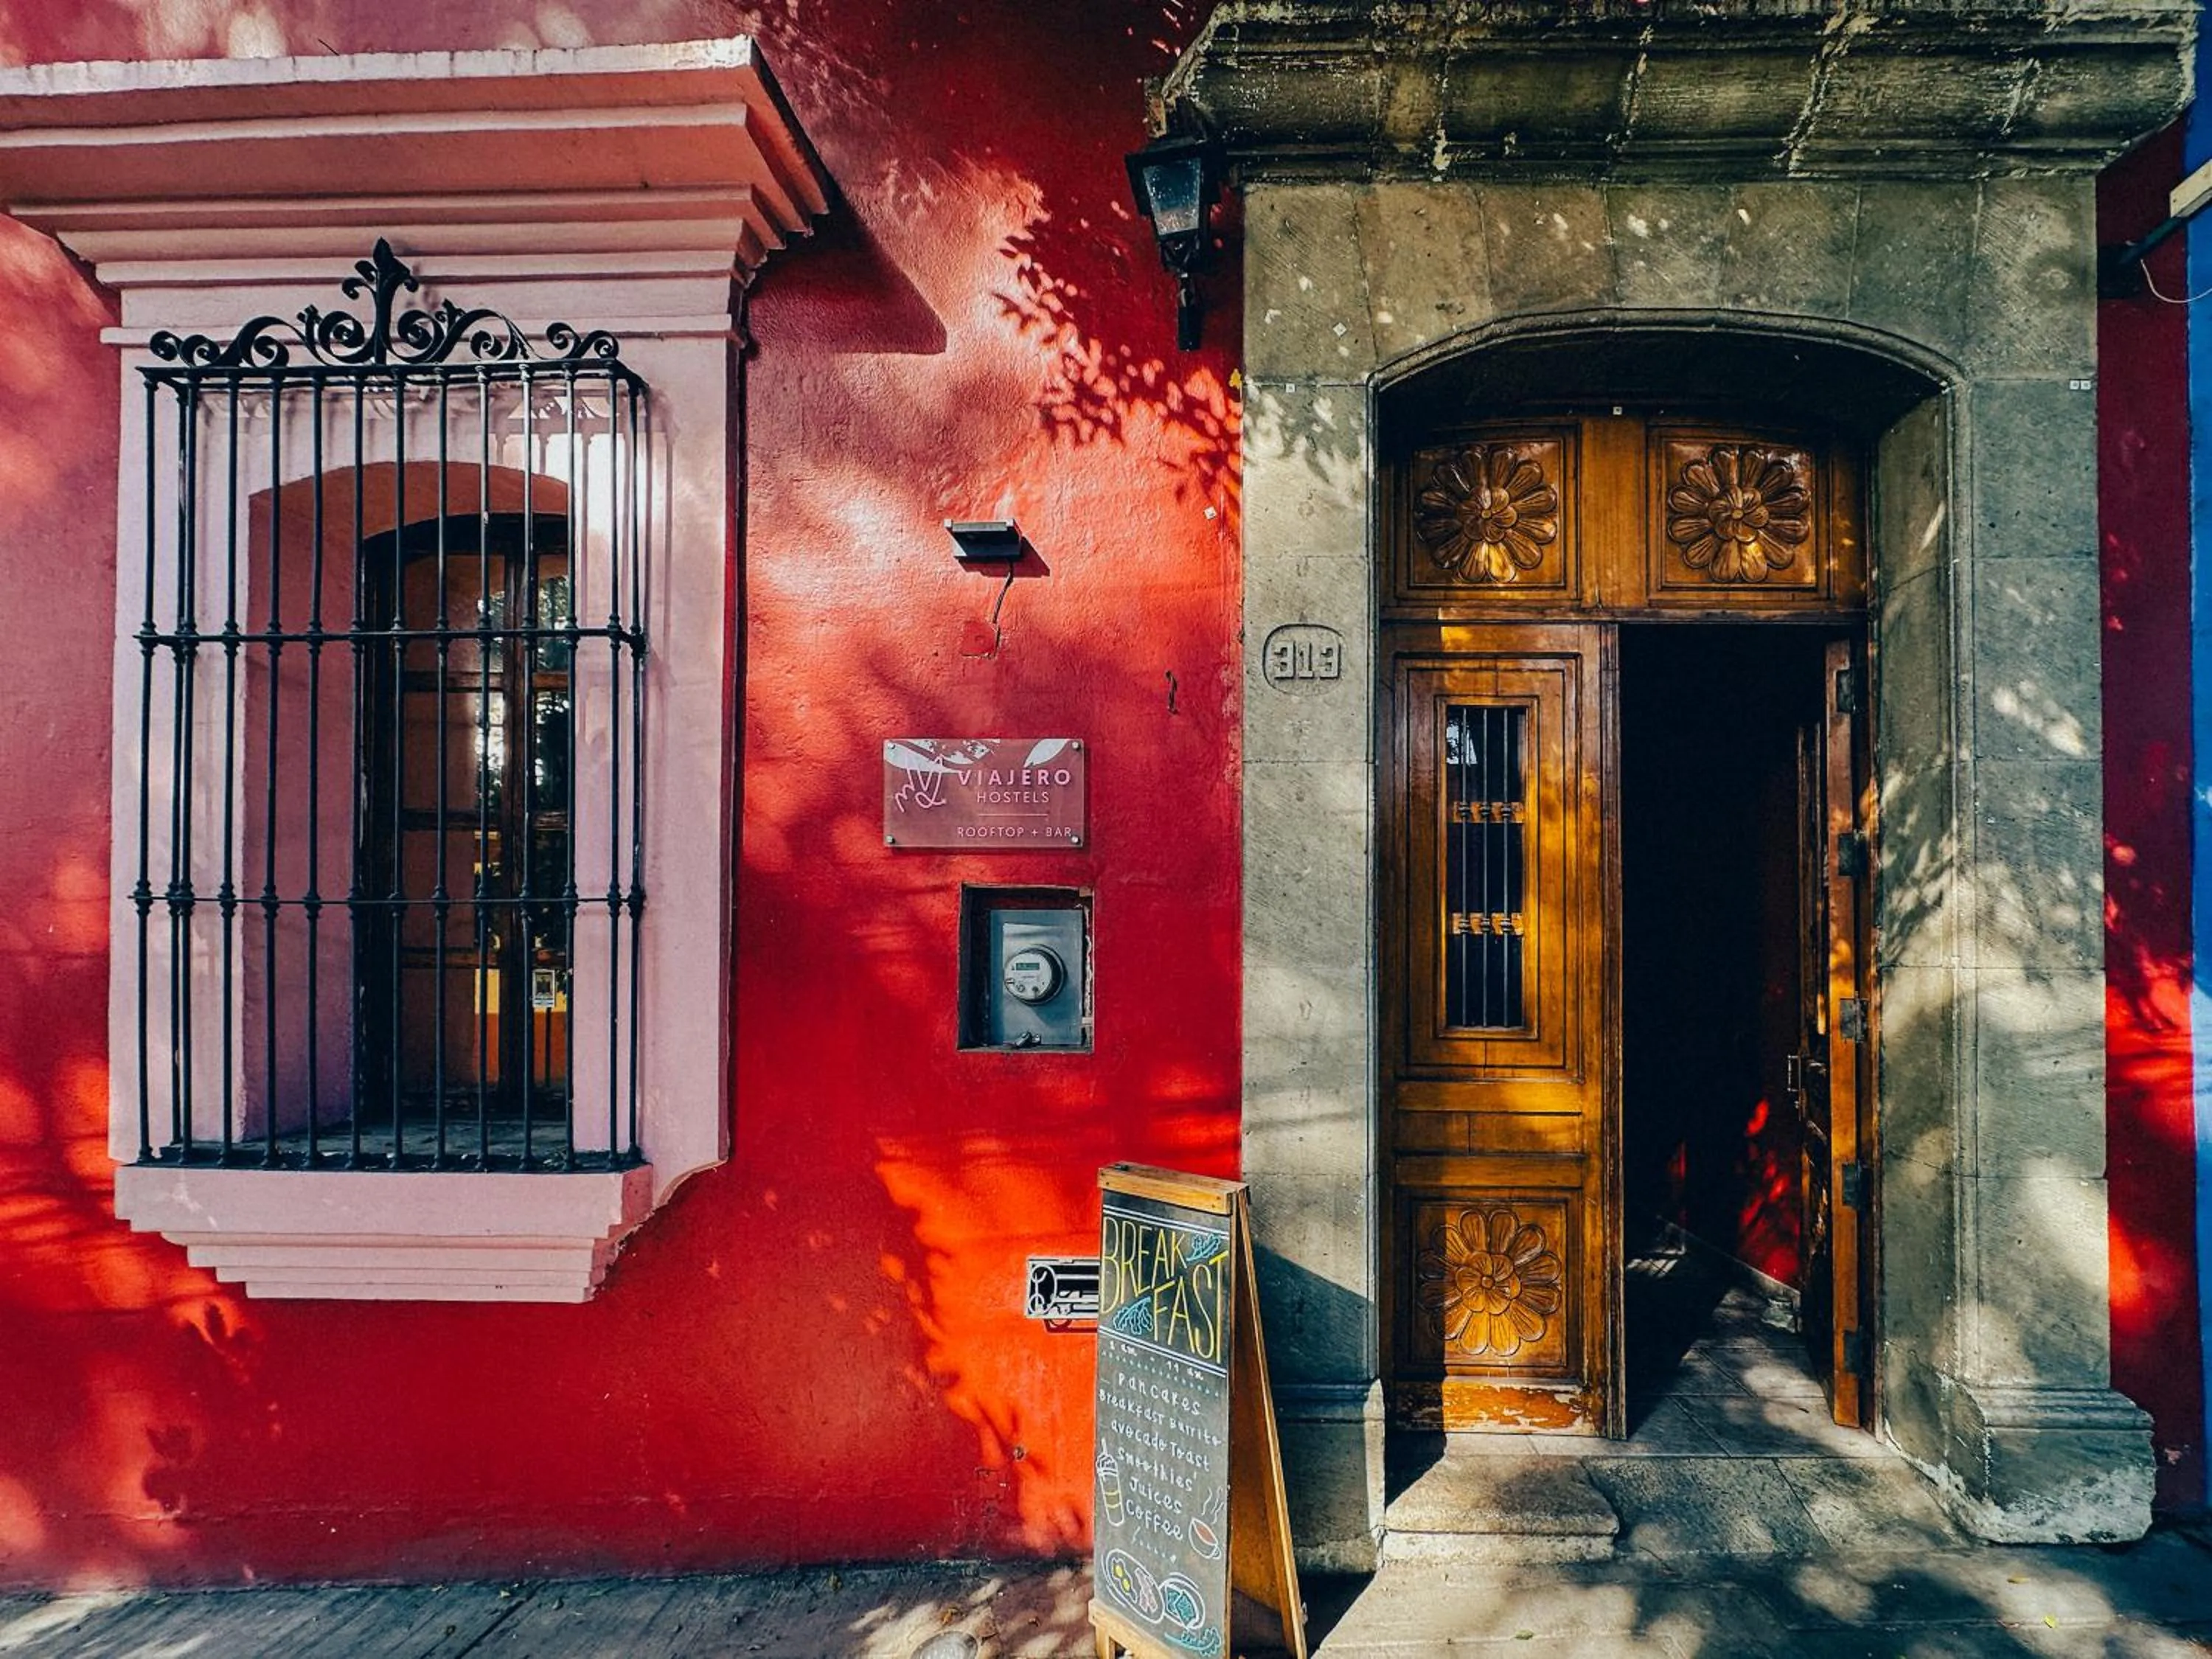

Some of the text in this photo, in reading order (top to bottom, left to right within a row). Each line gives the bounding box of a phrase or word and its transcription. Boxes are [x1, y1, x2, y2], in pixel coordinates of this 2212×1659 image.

[1273, 639, 1341, 680] 313
[959, 769, 1071, 785] VIAJERO
[977, 791, 1049, 803] HOSTELS
[958, 827, 1024, 837] ROOFTOP
[1046, 827, 1072, 837] BAR
[1101, 1216, 1188, 1314] BREAK
[1153, 1250, 1229, 1365] FAST
